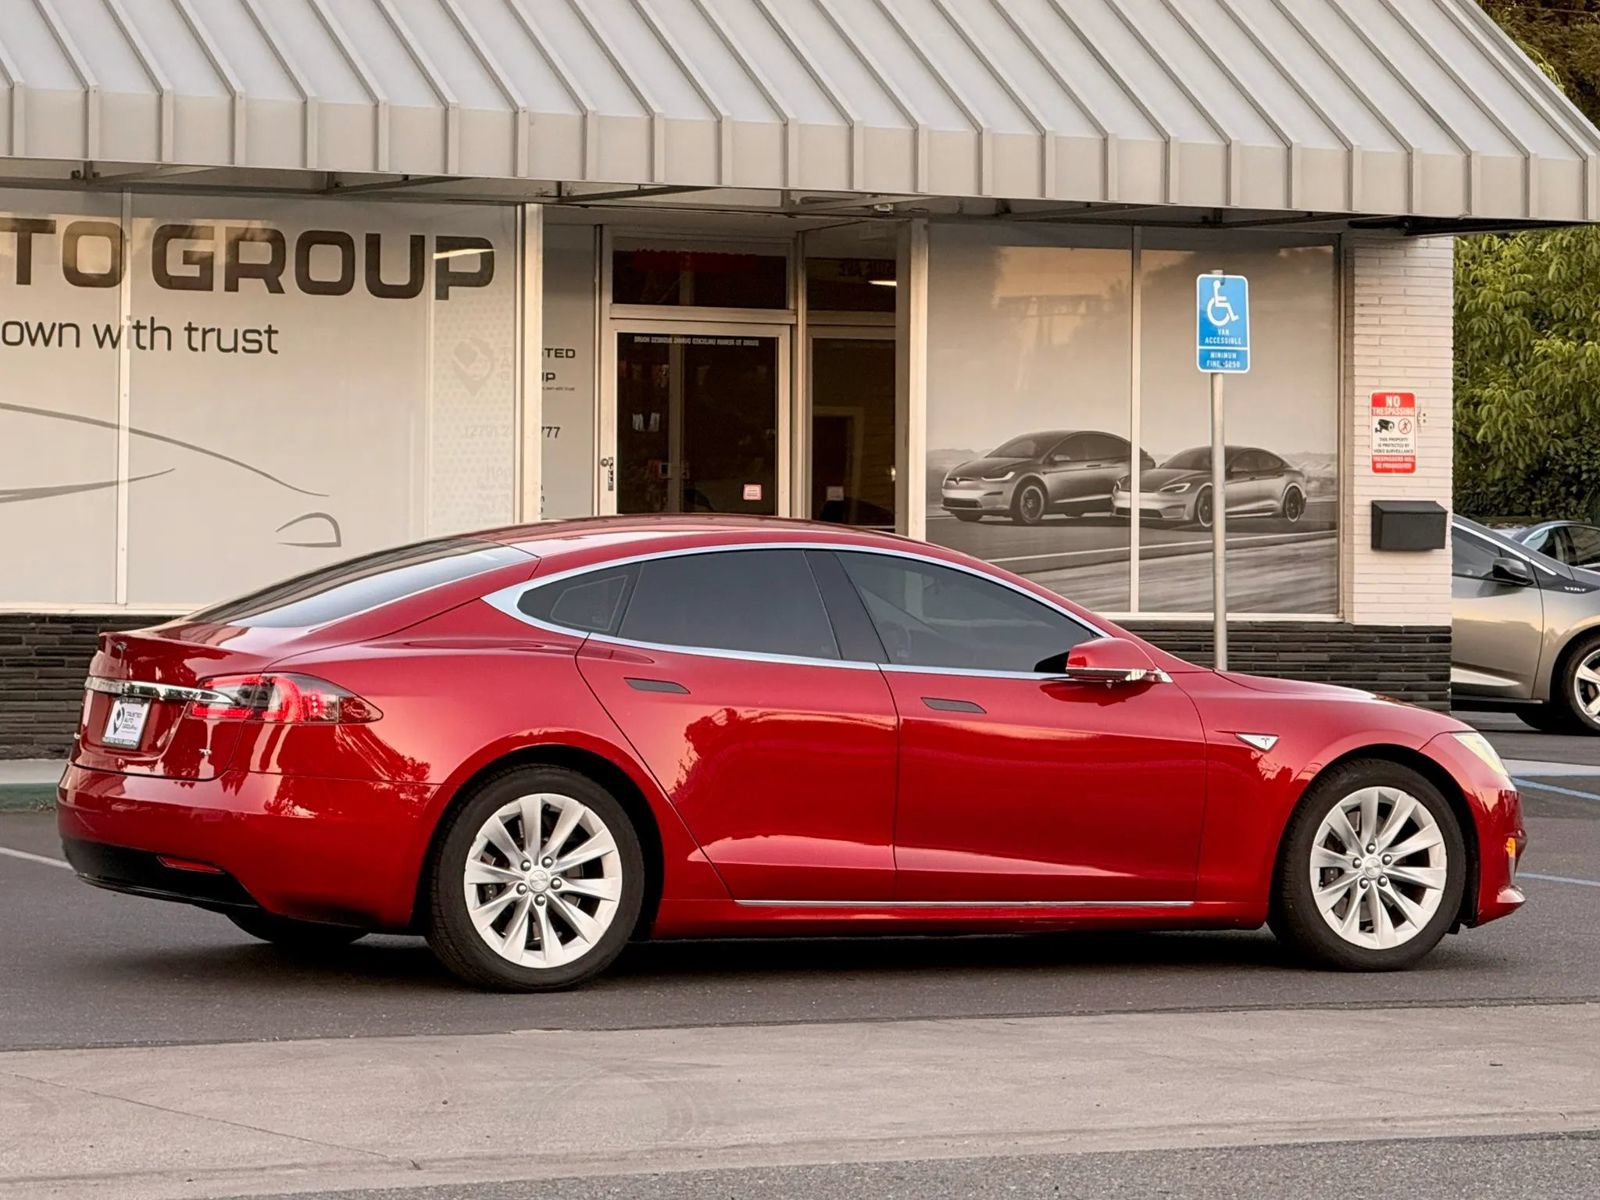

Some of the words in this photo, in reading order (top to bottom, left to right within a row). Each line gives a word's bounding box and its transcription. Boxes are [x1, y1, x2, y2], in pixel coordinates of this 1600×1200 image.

[0, 217, 126, 288] TO
[152, 222, 496, 301] GROUP
[2, 320, 81, 348] own
[184, 321, 279, 354] trust
[1217, 328, 1230, 336] VAN
[1204, 336, 1242, 345] ACCESSIBLE
[541, 347, 576, 359] TED
[1210, 351, 1237, 360] MINIMUM
[1206, 360, 1220, 368] FINE
[1385, 394, 1401, 408] NO
